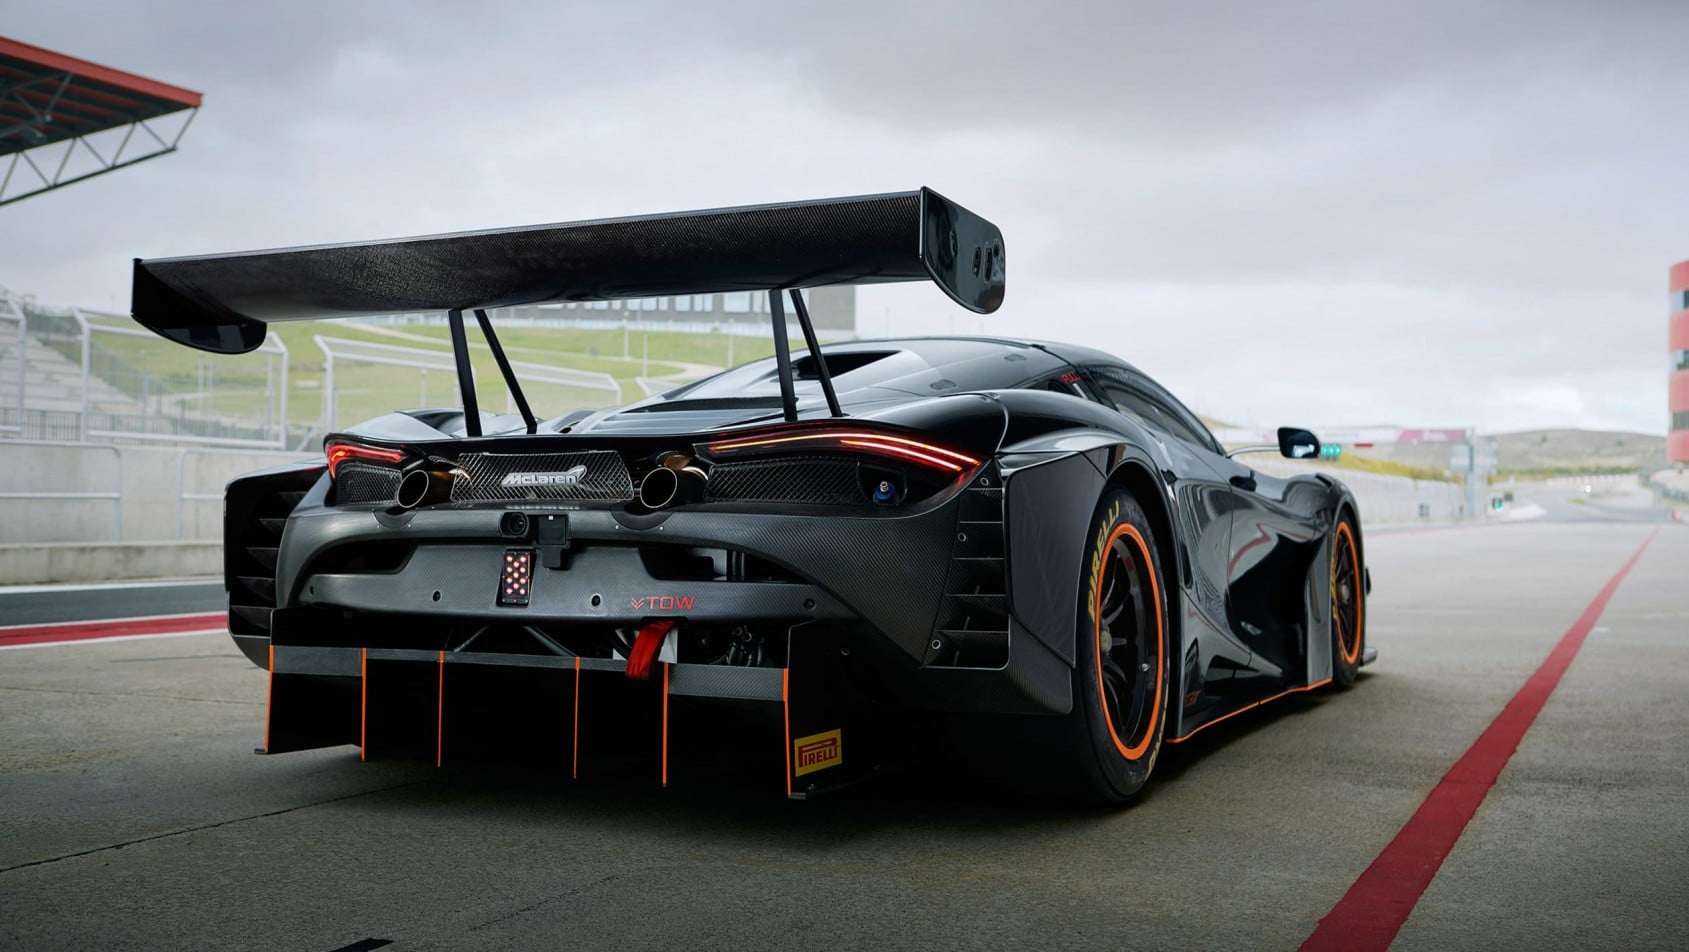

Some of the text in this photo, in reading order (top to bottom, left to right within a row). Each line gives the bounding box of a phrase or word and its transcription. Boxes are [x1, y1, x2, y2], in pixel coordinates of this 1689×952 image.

[501, 471, 579, 487] McLaren
[1087, 499, 1120, 623] PIRELLI
[646, 595, 696, 610] TOW
[798, 737, 838, 769] PIRELLI
